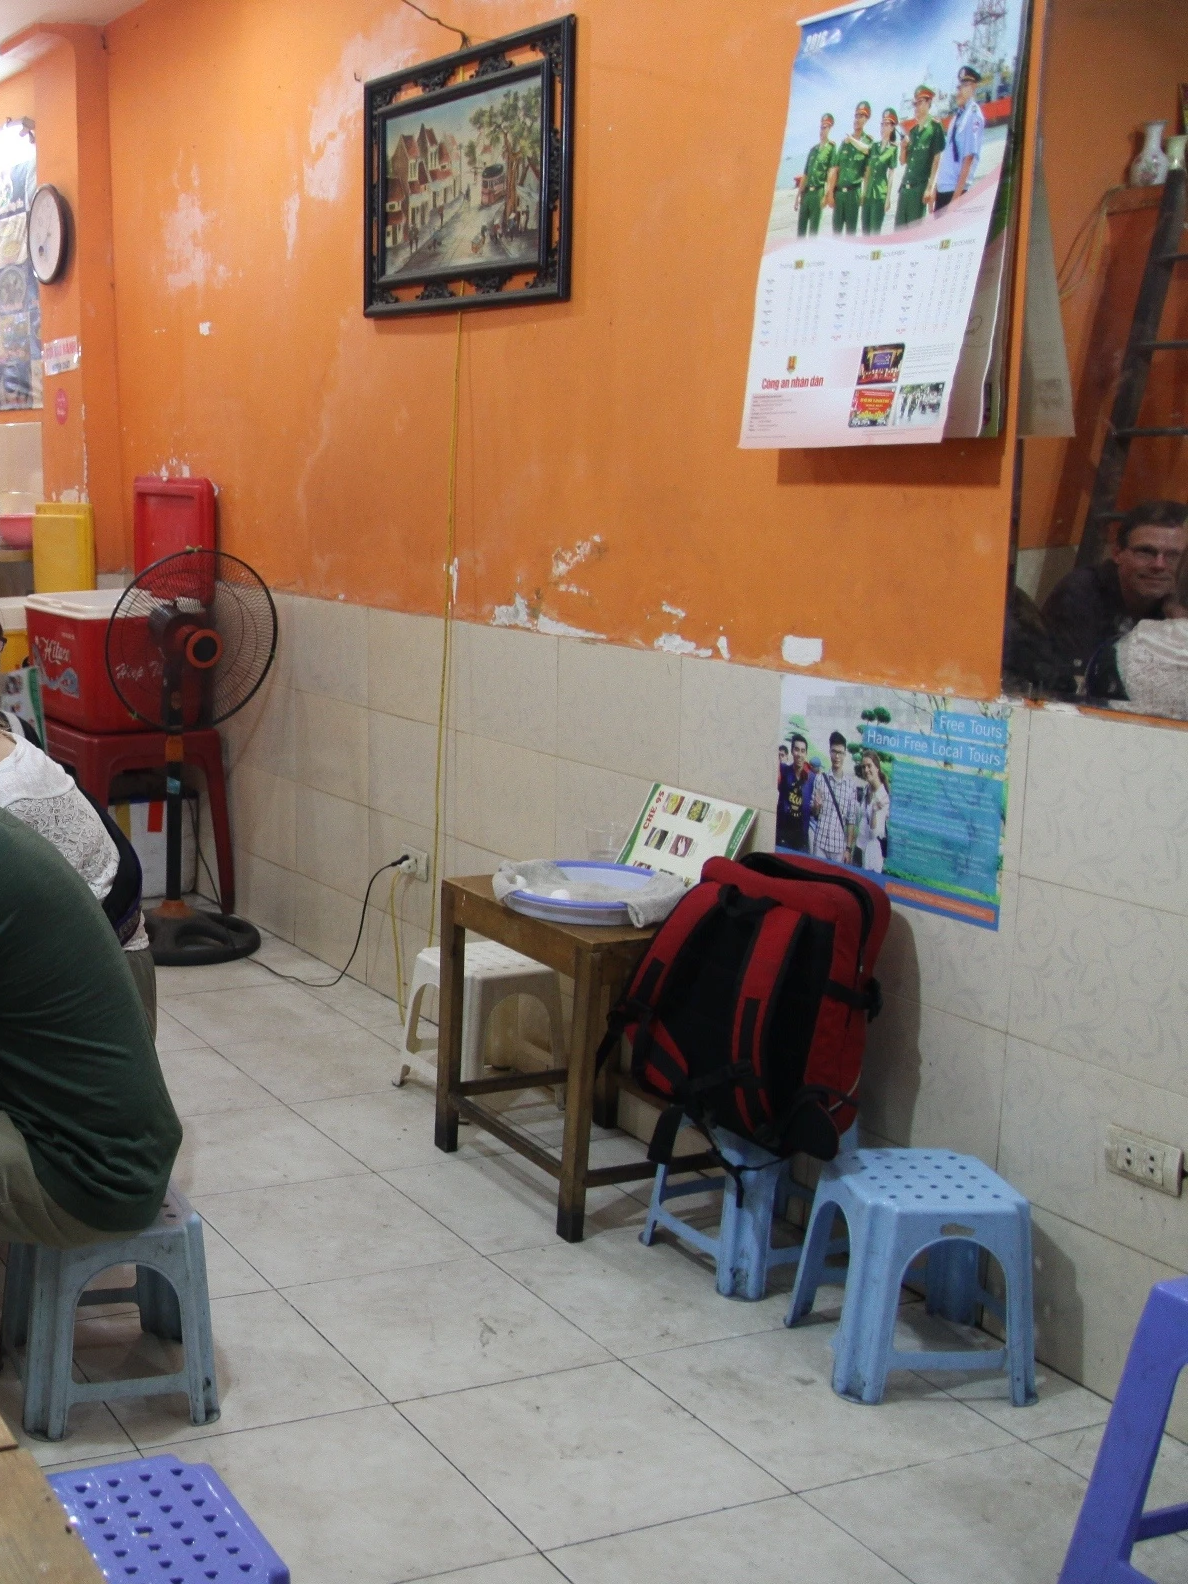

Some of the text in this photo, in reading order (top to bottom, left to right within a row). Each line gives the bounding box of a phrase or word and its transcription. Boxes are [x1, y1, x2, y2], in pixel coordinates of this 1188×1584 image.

[940, 715, 1002, 739] Free Tours
[867, 729, 1001, 766] Hanoi Free Local Tours
